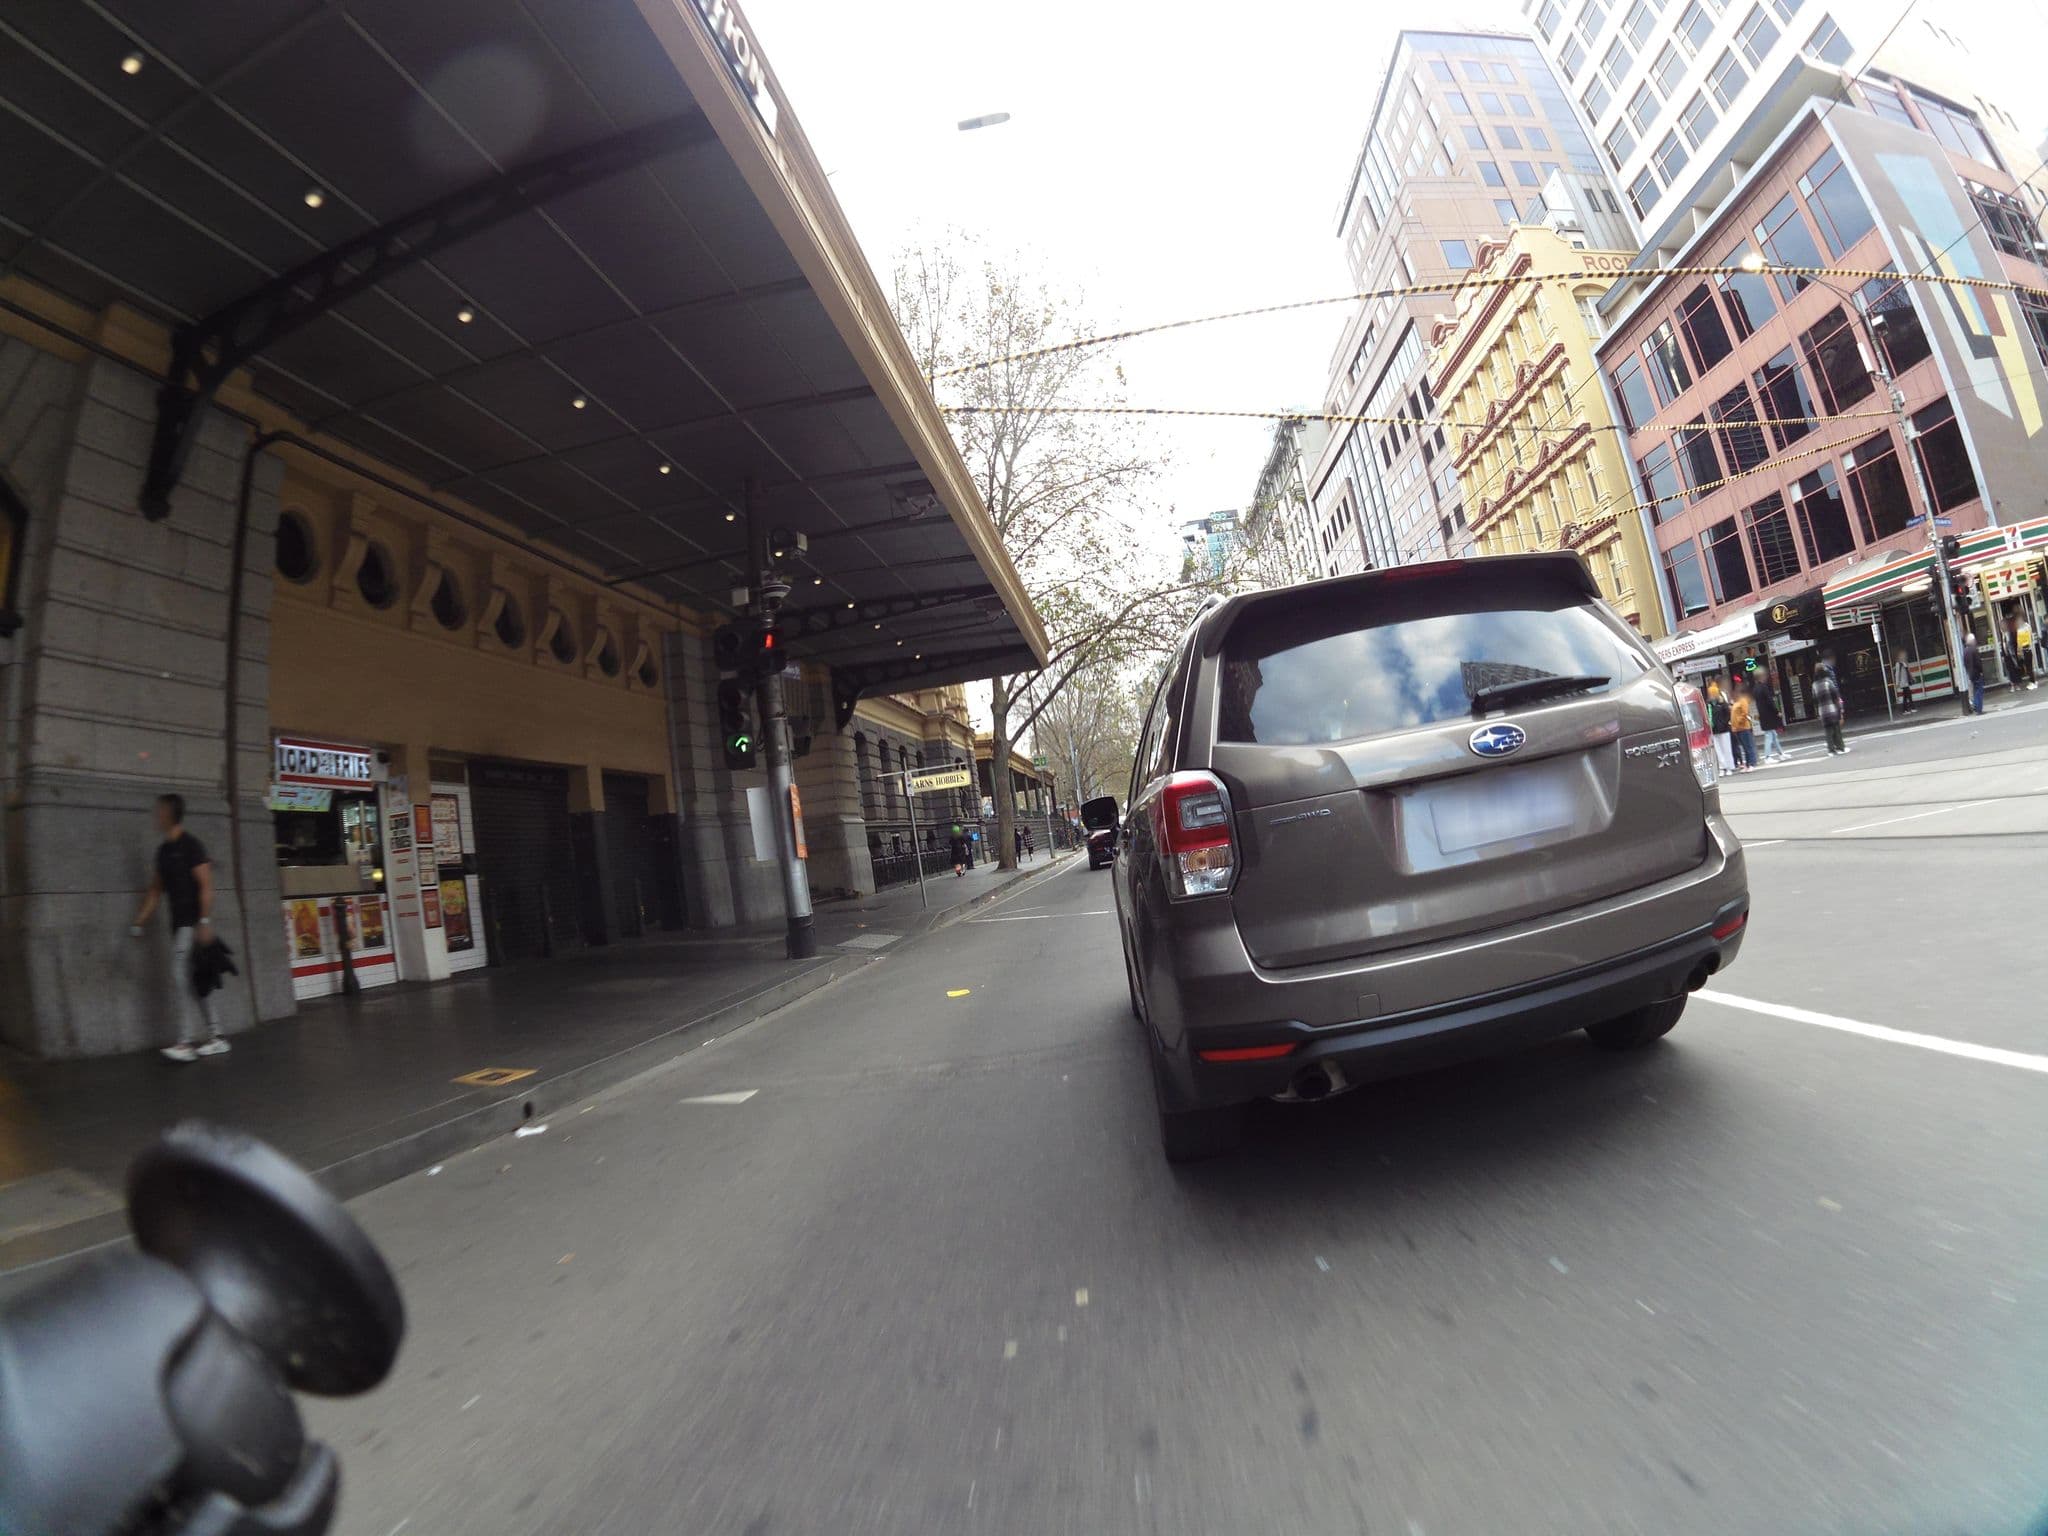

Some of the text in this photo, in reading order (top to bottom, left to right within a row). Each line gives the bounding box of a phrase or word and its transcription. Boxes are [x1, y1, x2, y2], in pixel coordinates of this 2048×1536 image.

[1624, 738, 1681, 759] FORESTER
[279, 747, 320, 775] LORD
[334, 753, 371, 780] FRIES
[1657, 751, 1681, 769] XT
[935, 774, 965, 786] HOBBIES
